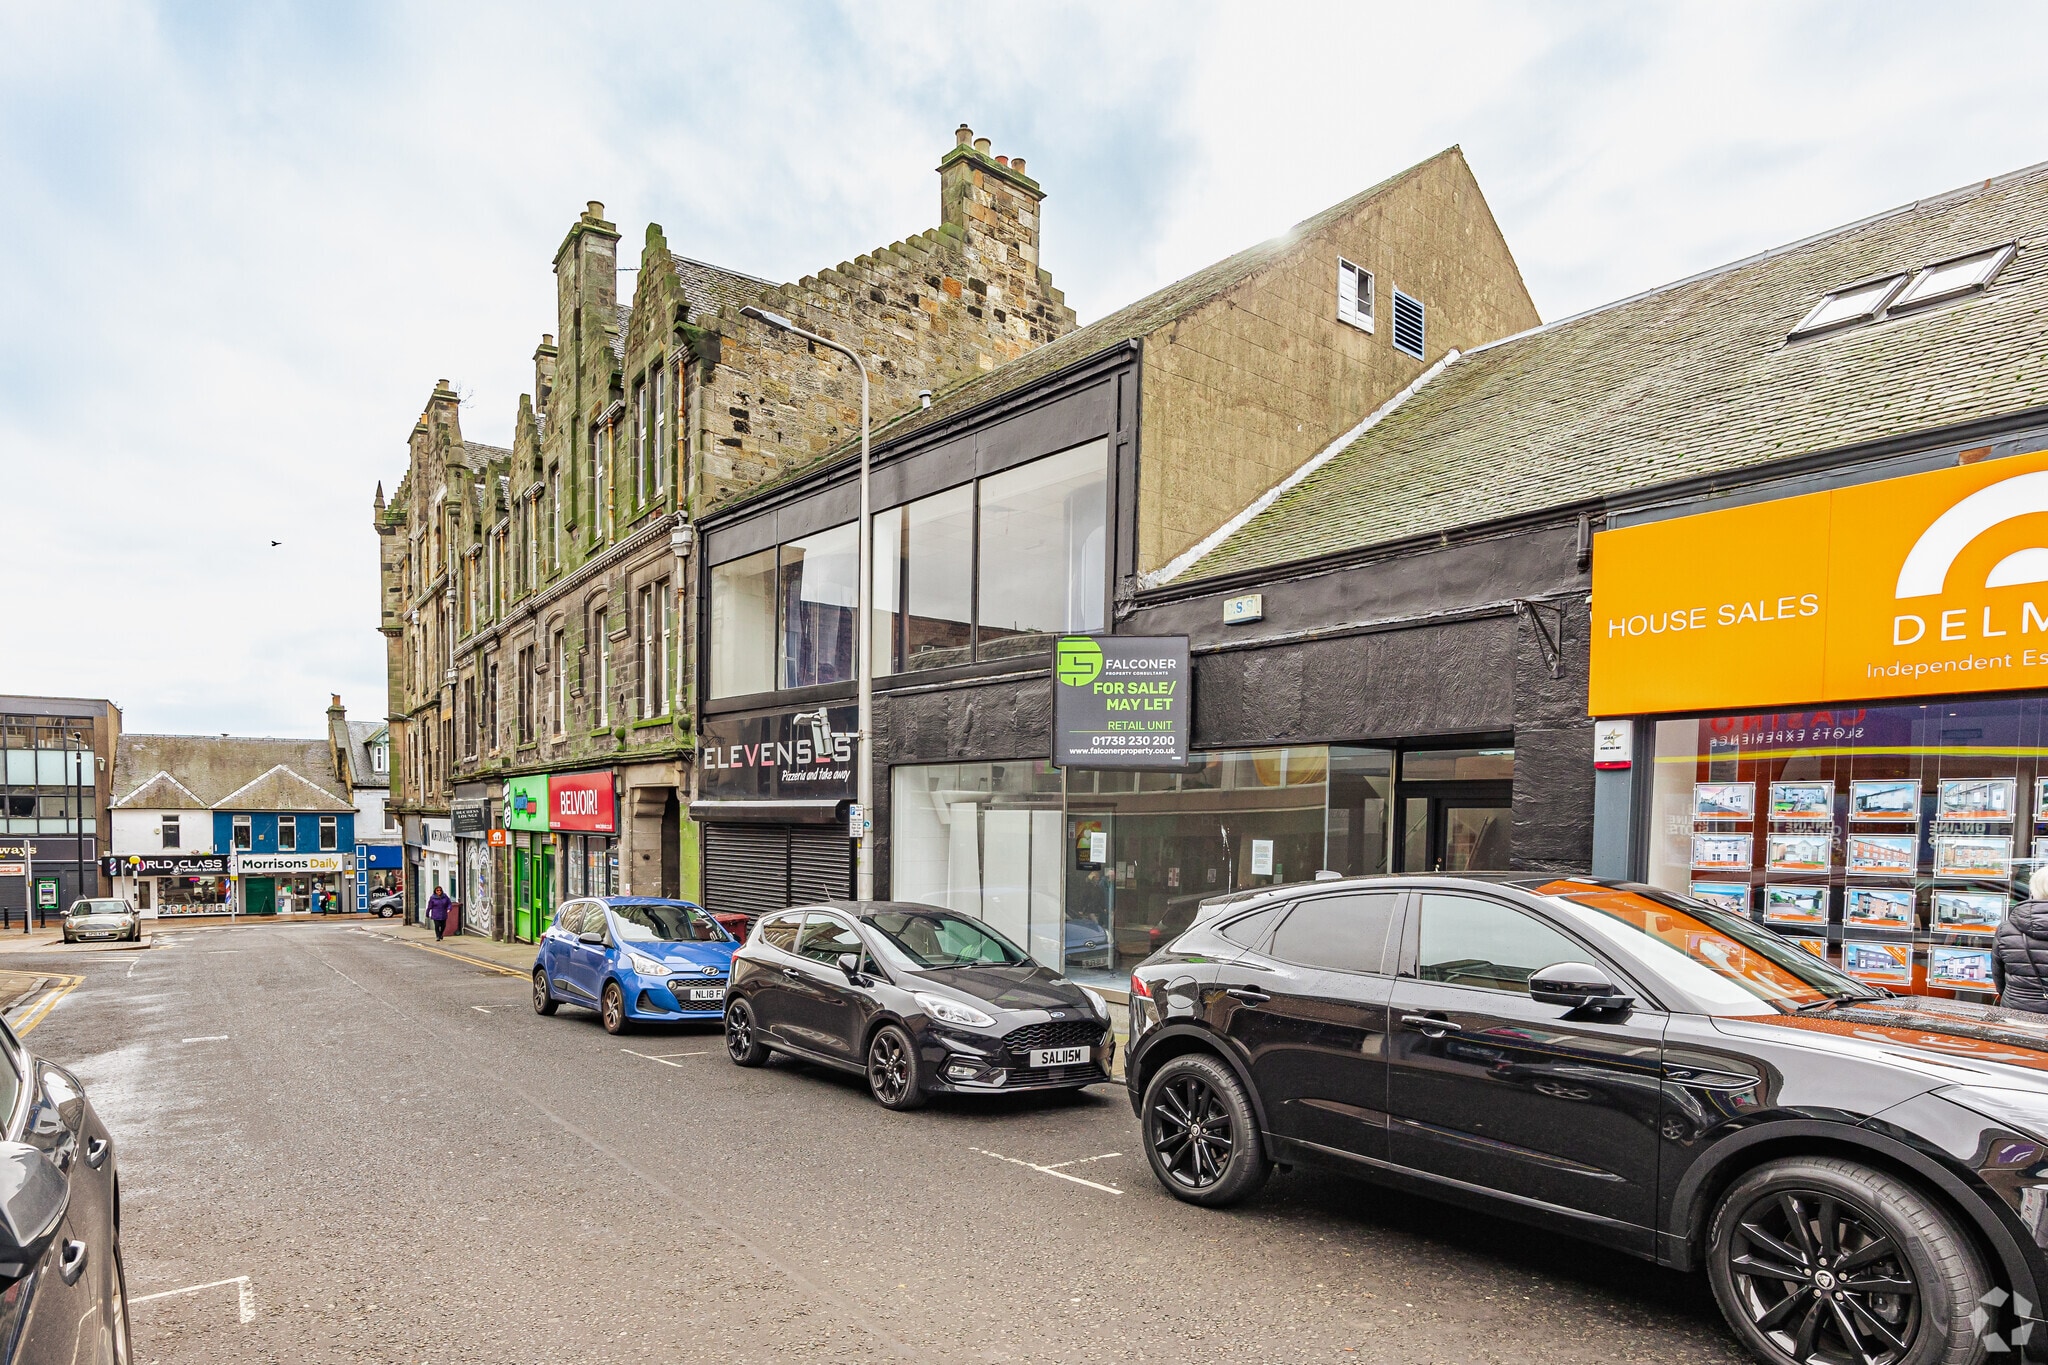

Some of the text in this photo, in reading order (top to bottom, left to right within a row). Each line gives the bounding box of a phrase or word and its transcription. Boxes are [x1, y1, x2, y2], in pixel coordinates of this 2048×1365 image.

[1608, 593, 1819, 639] HOUSE SALES
[1105, 659, 1177, 670] FALCONER
[1867, 653, 2013, 680] Independent
[1093, 680, 1177, 695] FOR SALE/
[1106, 698, 1174, 711] MAY LET
[1108, 720, 1173, 731] RETAIL UNIT
[1092, 735, 1175, 746] 01738 230 200
[704, 737, 851, 770] ELEVENSS
[1069, 747, 1176, 756] www.falconerproperty.co.uk
[781, 767, 851, 783] Pizzeria and take away
[560, 789, 599, 816] BELVOIR!
[178, 859, 223, 869] CLASS
[242, 857, 339, 870] Morrisons Daily
[695, 990, 715, 999] NL18
